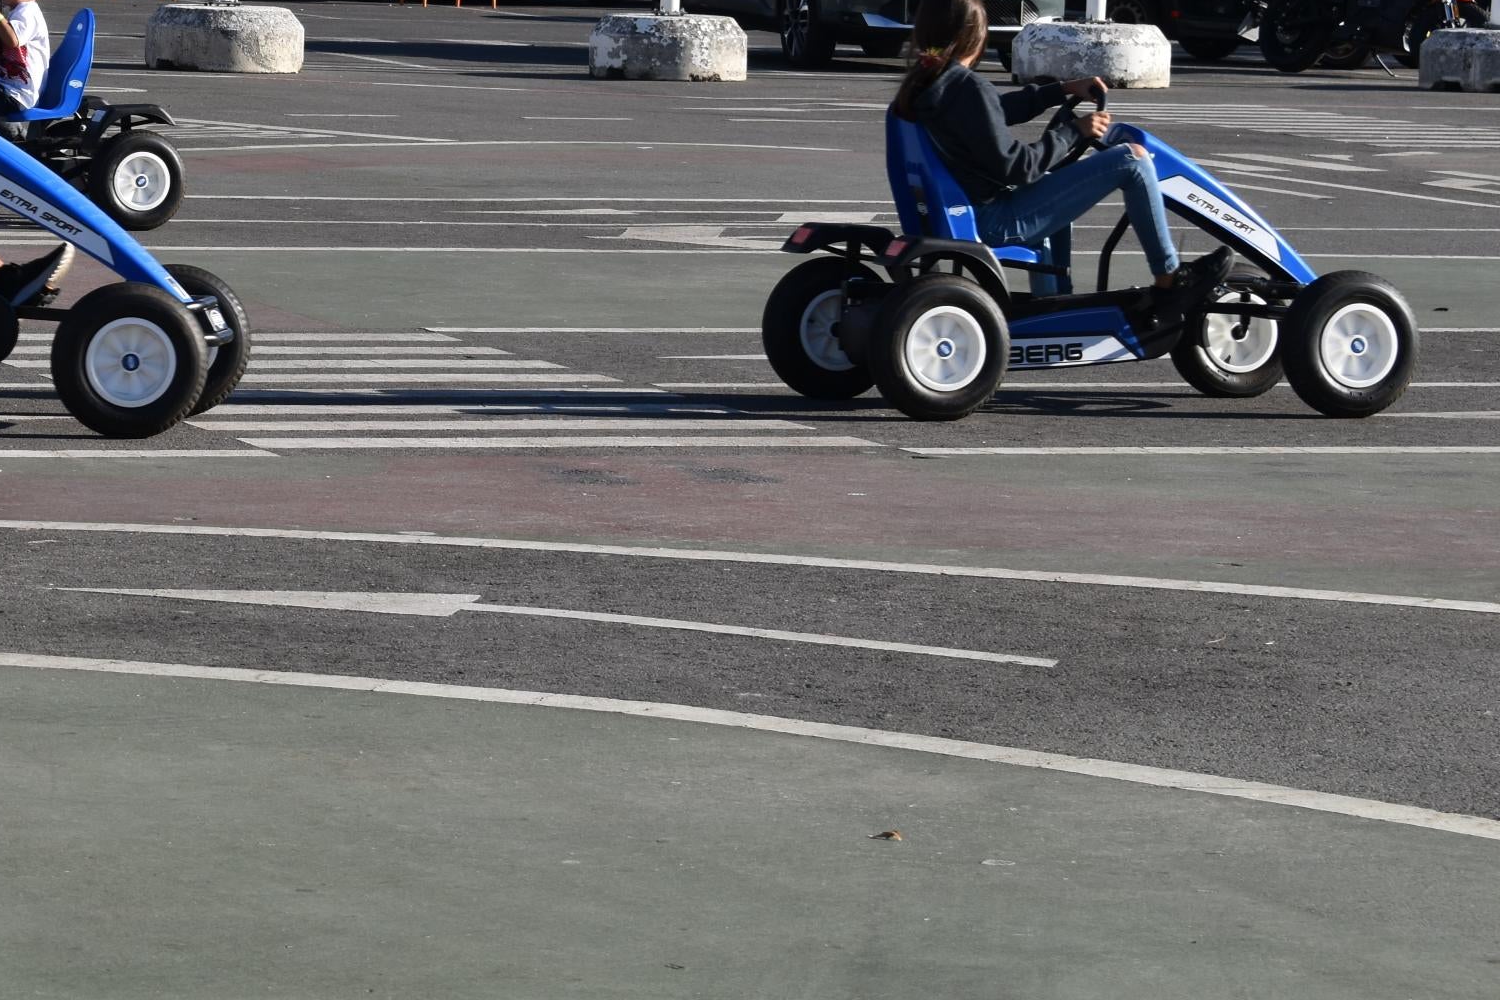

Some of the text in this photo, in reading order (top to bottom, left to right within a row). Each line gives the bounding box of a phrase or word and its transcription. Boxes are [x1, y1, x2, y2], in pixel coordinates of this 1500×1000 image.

[0, 188, 83, 236] EXTRA SPORT
[1186, 193, 1256, 235] EXTRA SPORT
[1008, 342, 1084, 365] BERG
